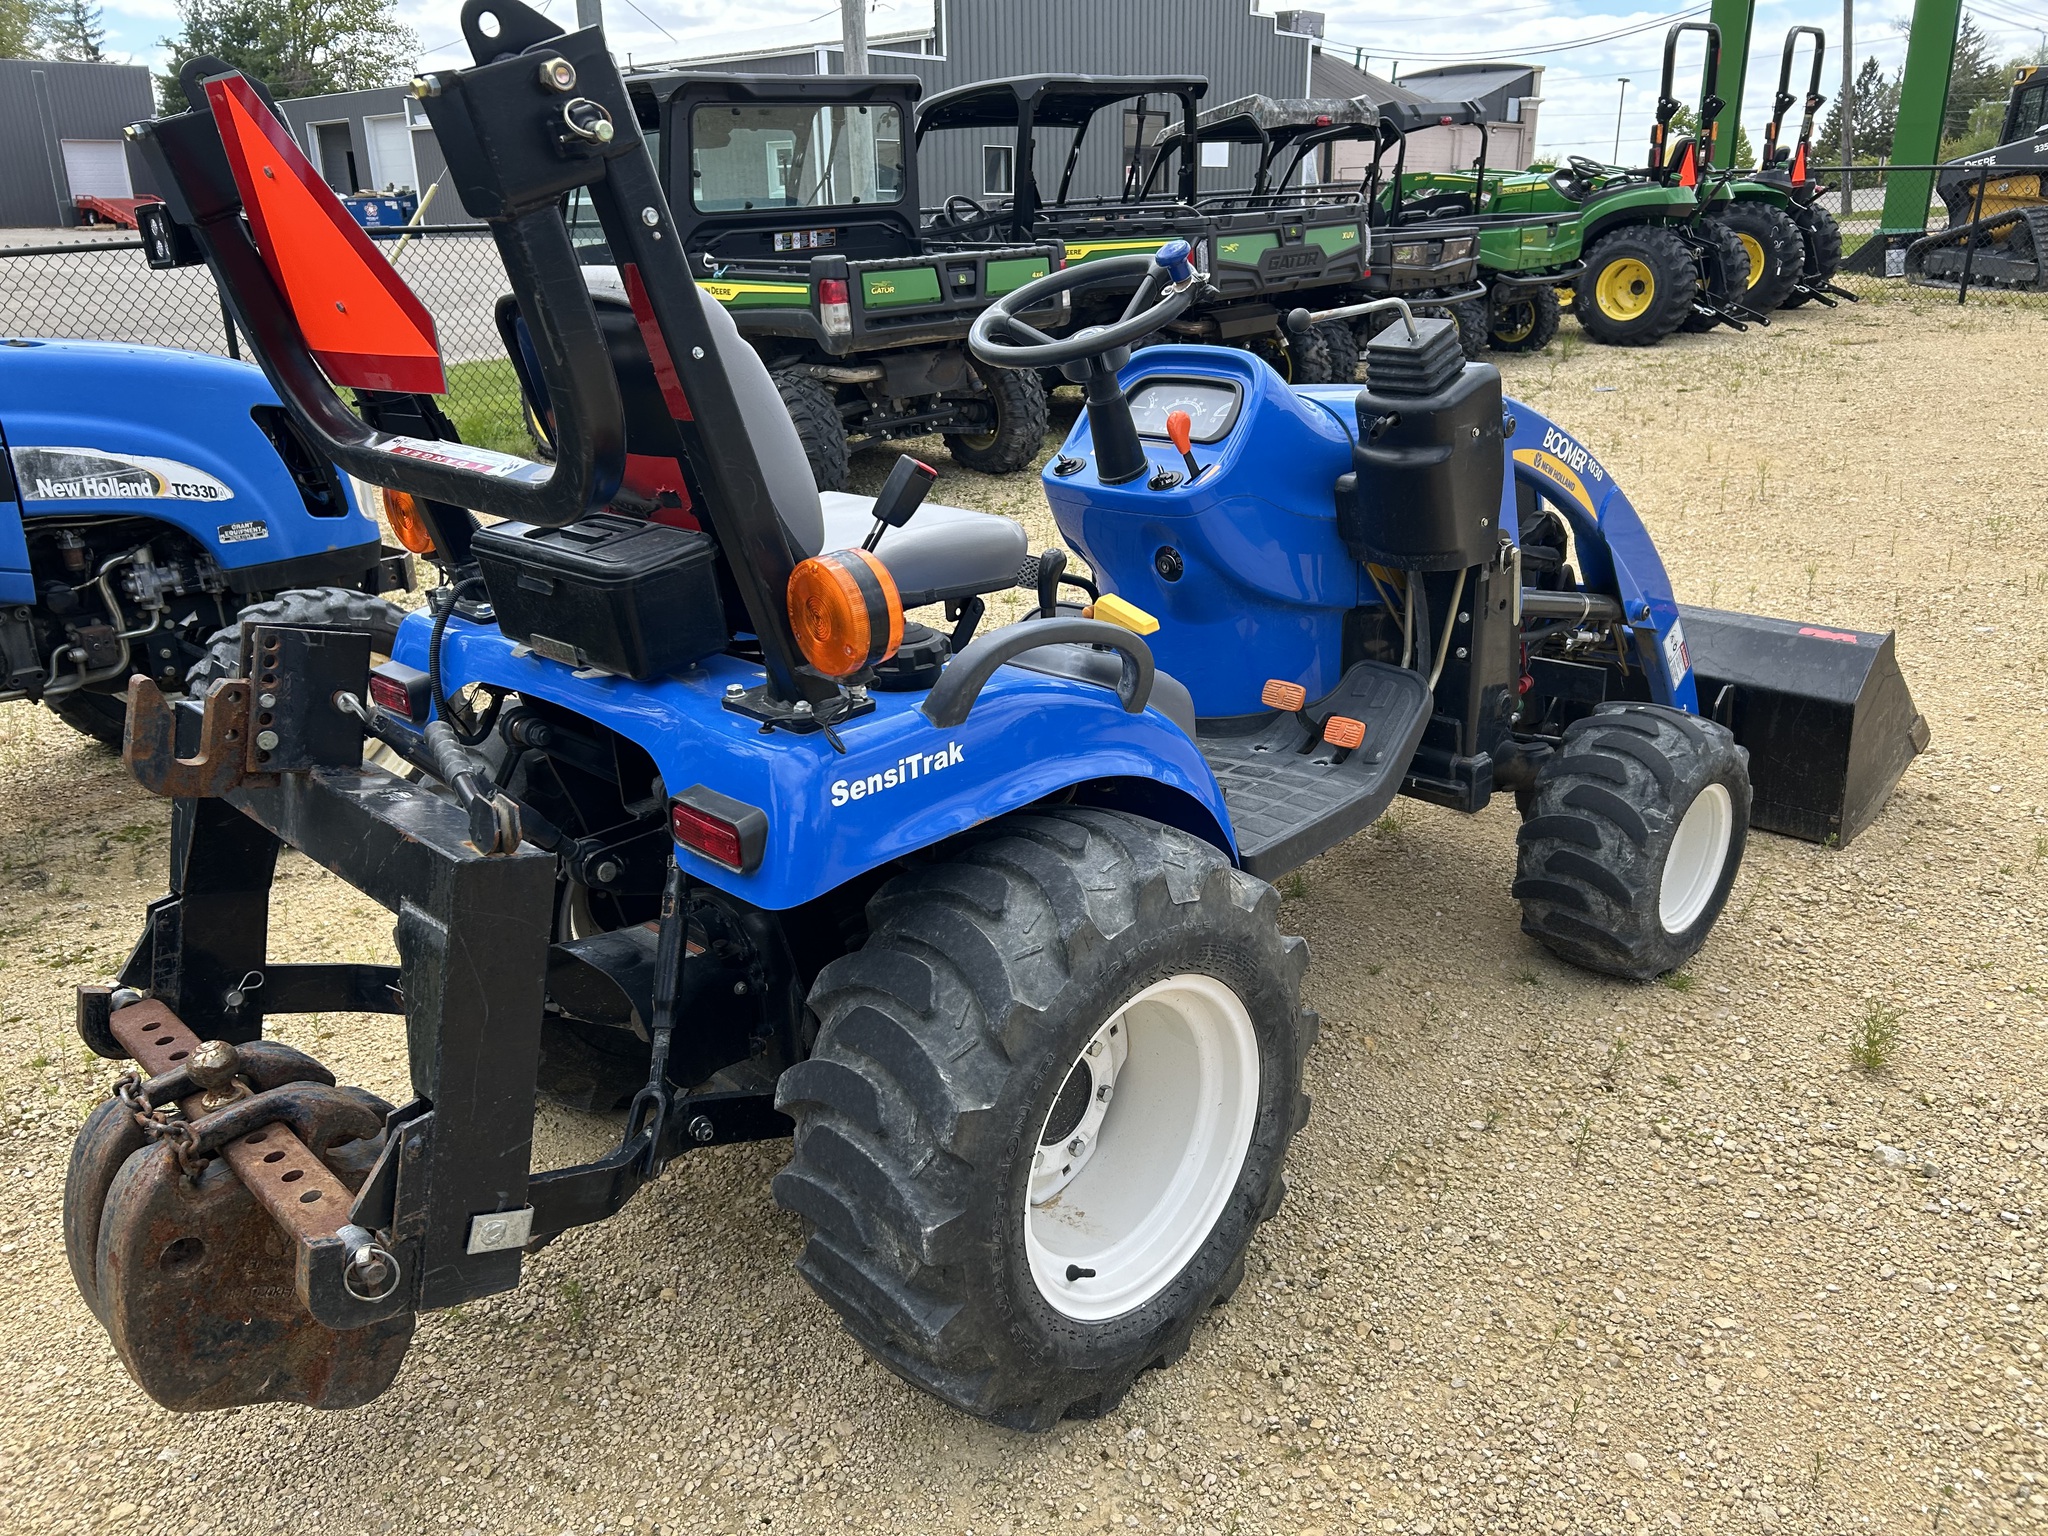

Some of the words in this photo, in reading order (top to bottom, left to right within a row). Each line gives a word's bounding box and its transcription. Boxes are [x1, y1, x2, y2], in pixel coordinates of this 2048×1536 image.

[1341, 231, 1355, 240] XUV
[1066, 248, 1082, 256] EERE
[1268, 252, 1319, 271] GATOR
[711, 286, 731, 296] DEERE
[870, 286, 895, 295] GATOR
[400, 447, 470, 469] DANGER
[1542, 426, 1588, 475] BOOMER
[1587, 457, 1603, 482] 1030
[1541, 460, 1555, 477] NEW
[1553, 469, 1576, 492] HOLLAND
[35, 477, 81, 498] New
[82, 476, 154, 498] Holland
[830, 741, 965, 808] SensiTrak
